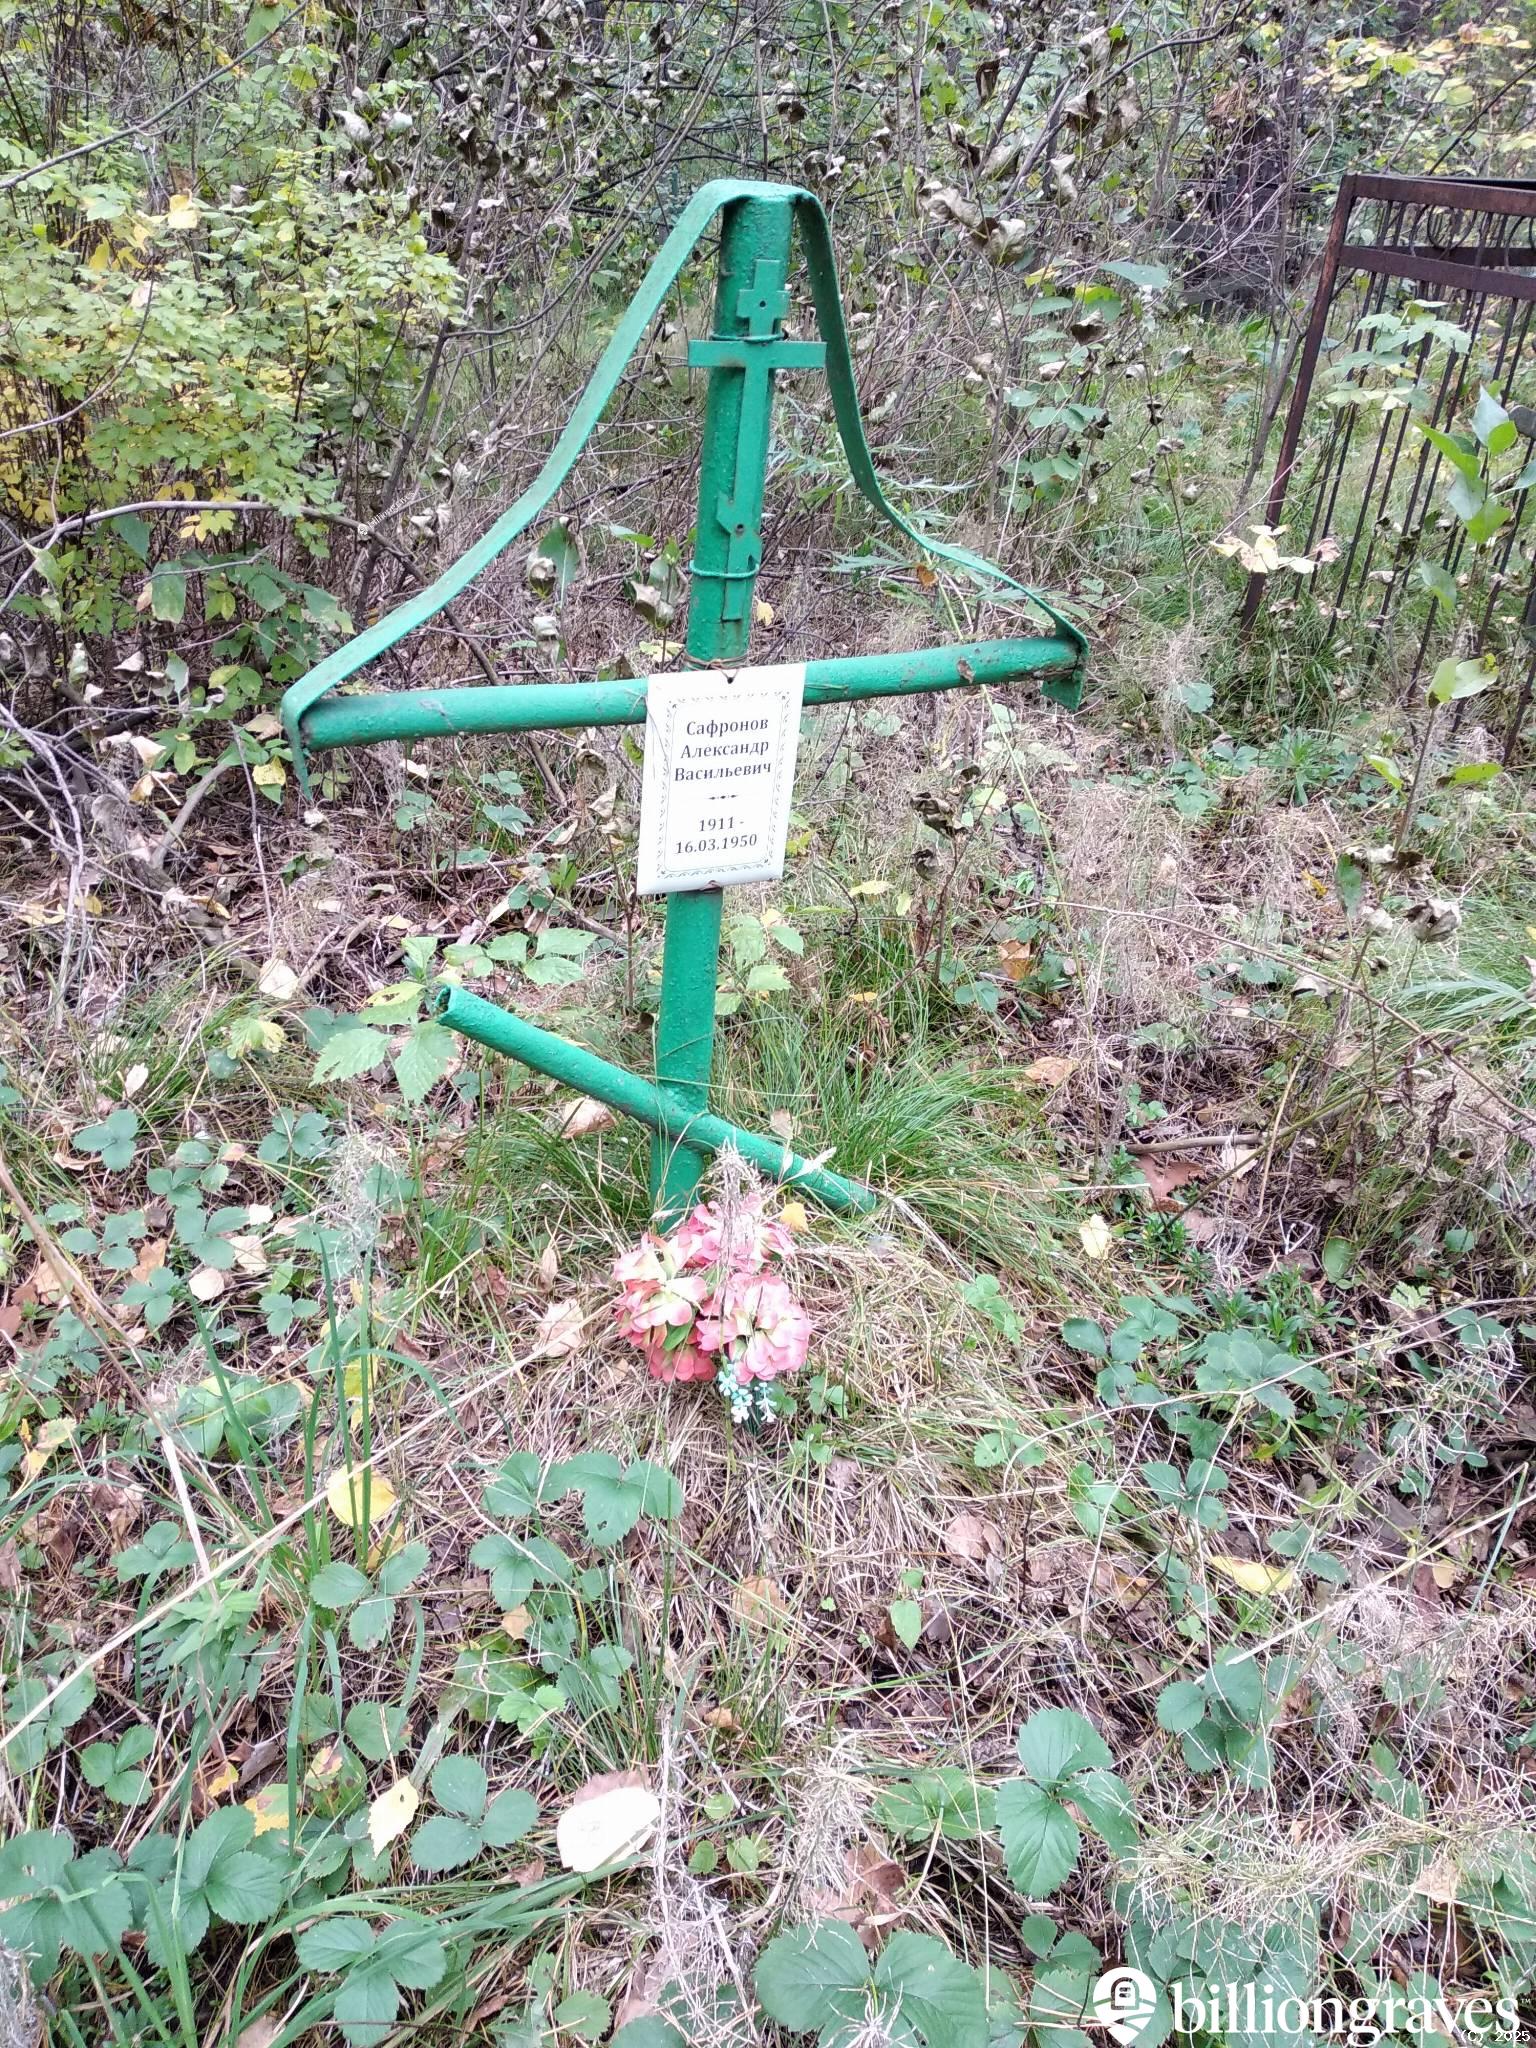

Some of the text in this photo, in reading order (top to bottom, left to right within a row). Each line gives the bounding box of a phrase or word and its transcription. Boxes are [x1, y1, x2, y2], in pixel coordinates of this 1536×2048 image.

[686, 718, 769, 738] Сафронов
[680, 740, 770, 759] Александр
[674, 762, 772, 782] Васильевич
[698, 816, 735, 832] 1911
[675, 833, 758, 854] 16.03.1950
